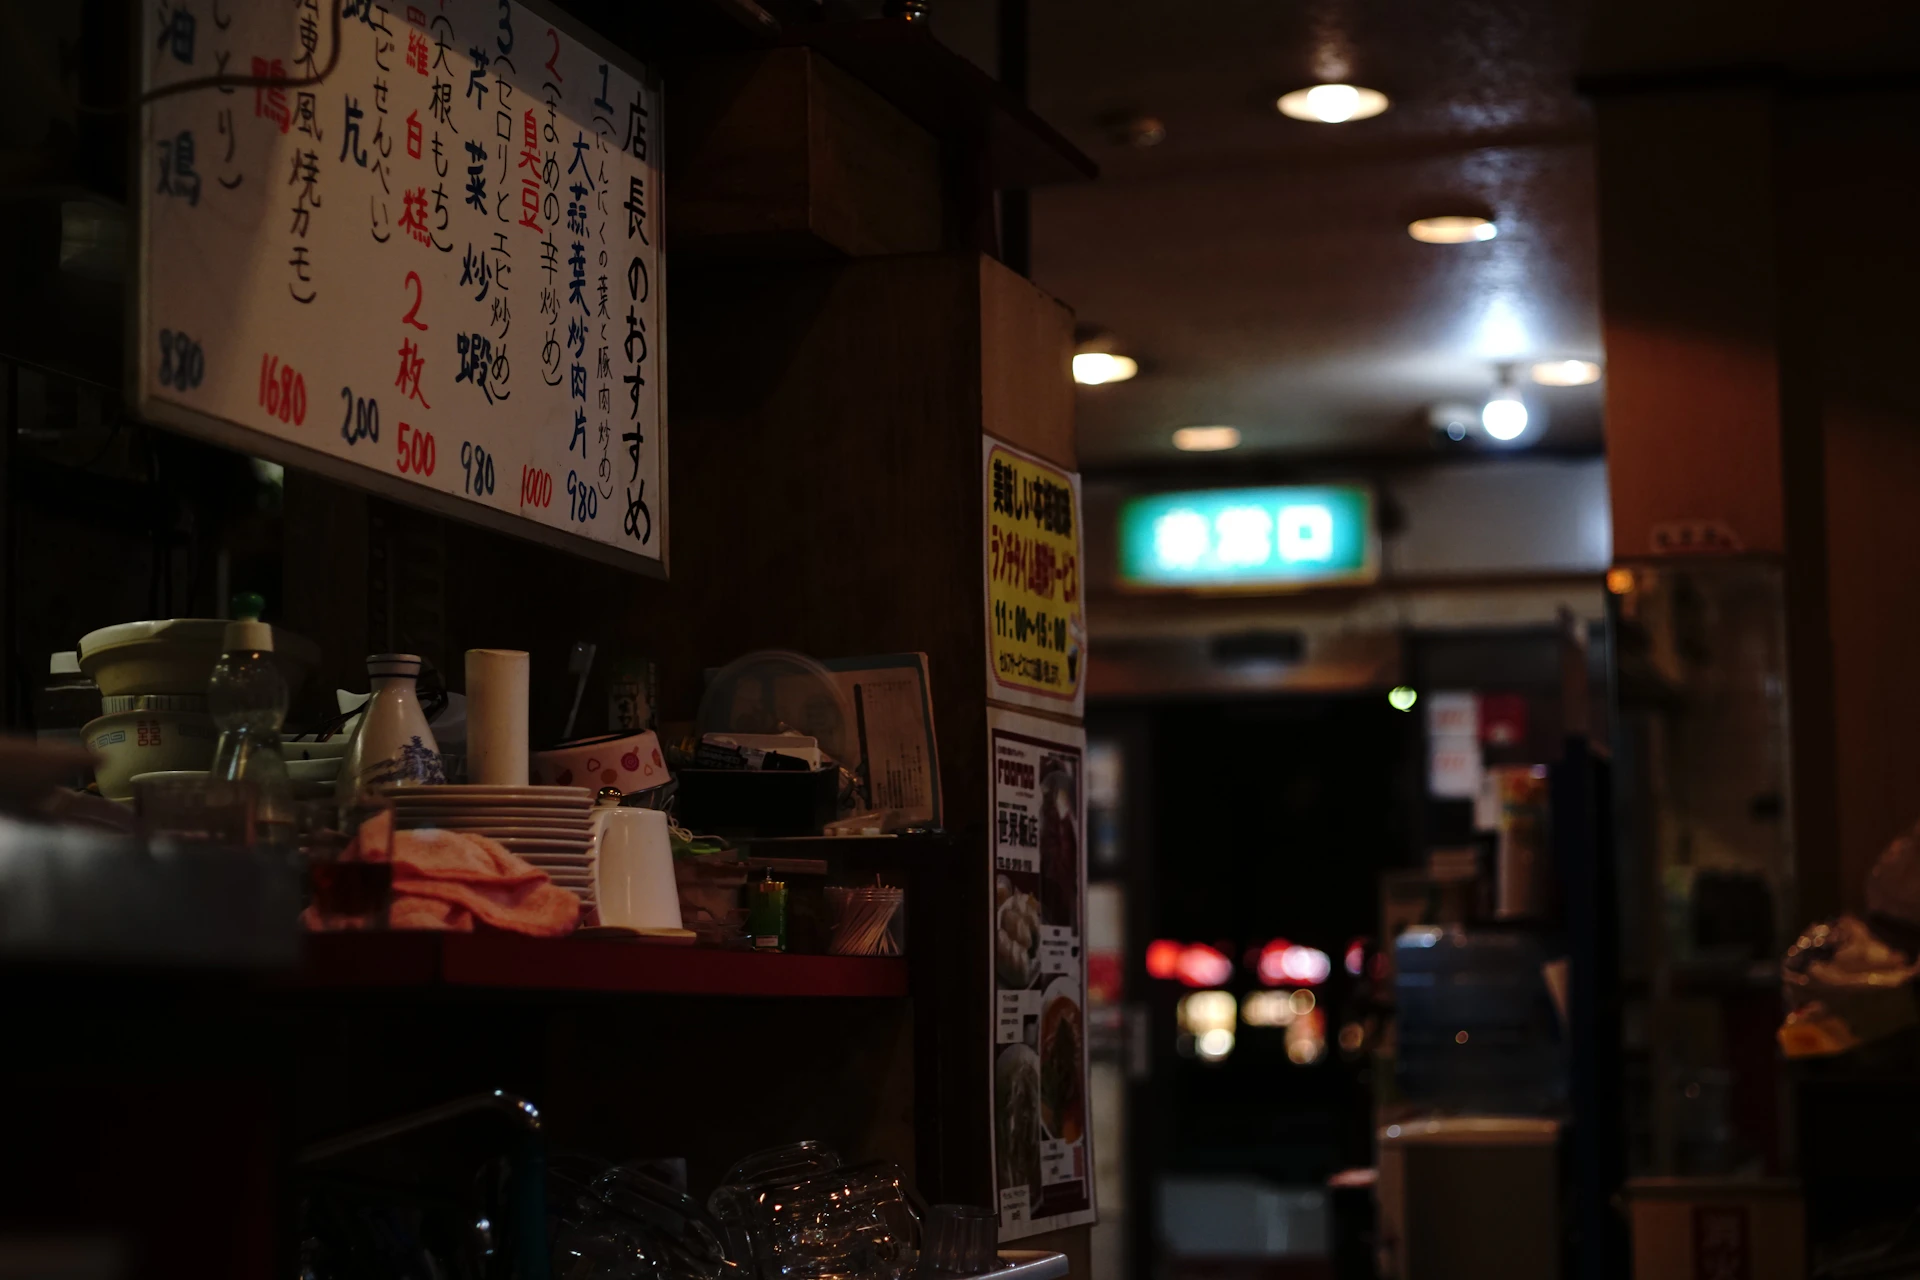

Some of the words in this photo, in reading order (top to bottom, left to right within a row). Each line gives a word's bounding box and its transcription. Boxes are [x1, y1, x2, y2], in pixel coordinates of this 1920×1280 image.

[497, 0, 513, 54] 3
[545, 28, 563, 83] 2
[594, 64, 614, 114] 1
[429, 15, 459, 253] （大根もち）
[622, 91, 652, 545] 店長のおすすめ
[159, 328, 205, 392] 880
[258, 353, 307, 426] 1680
[340, 386, 379, 446] 200
[396, 422, 436, 477] 500
[461, 441, 495, 496] 980
[520, 464, 552, 508] 1000
[567, 470, 597, 522] 980
[998, 810, 1038, 848] 世界飯店
